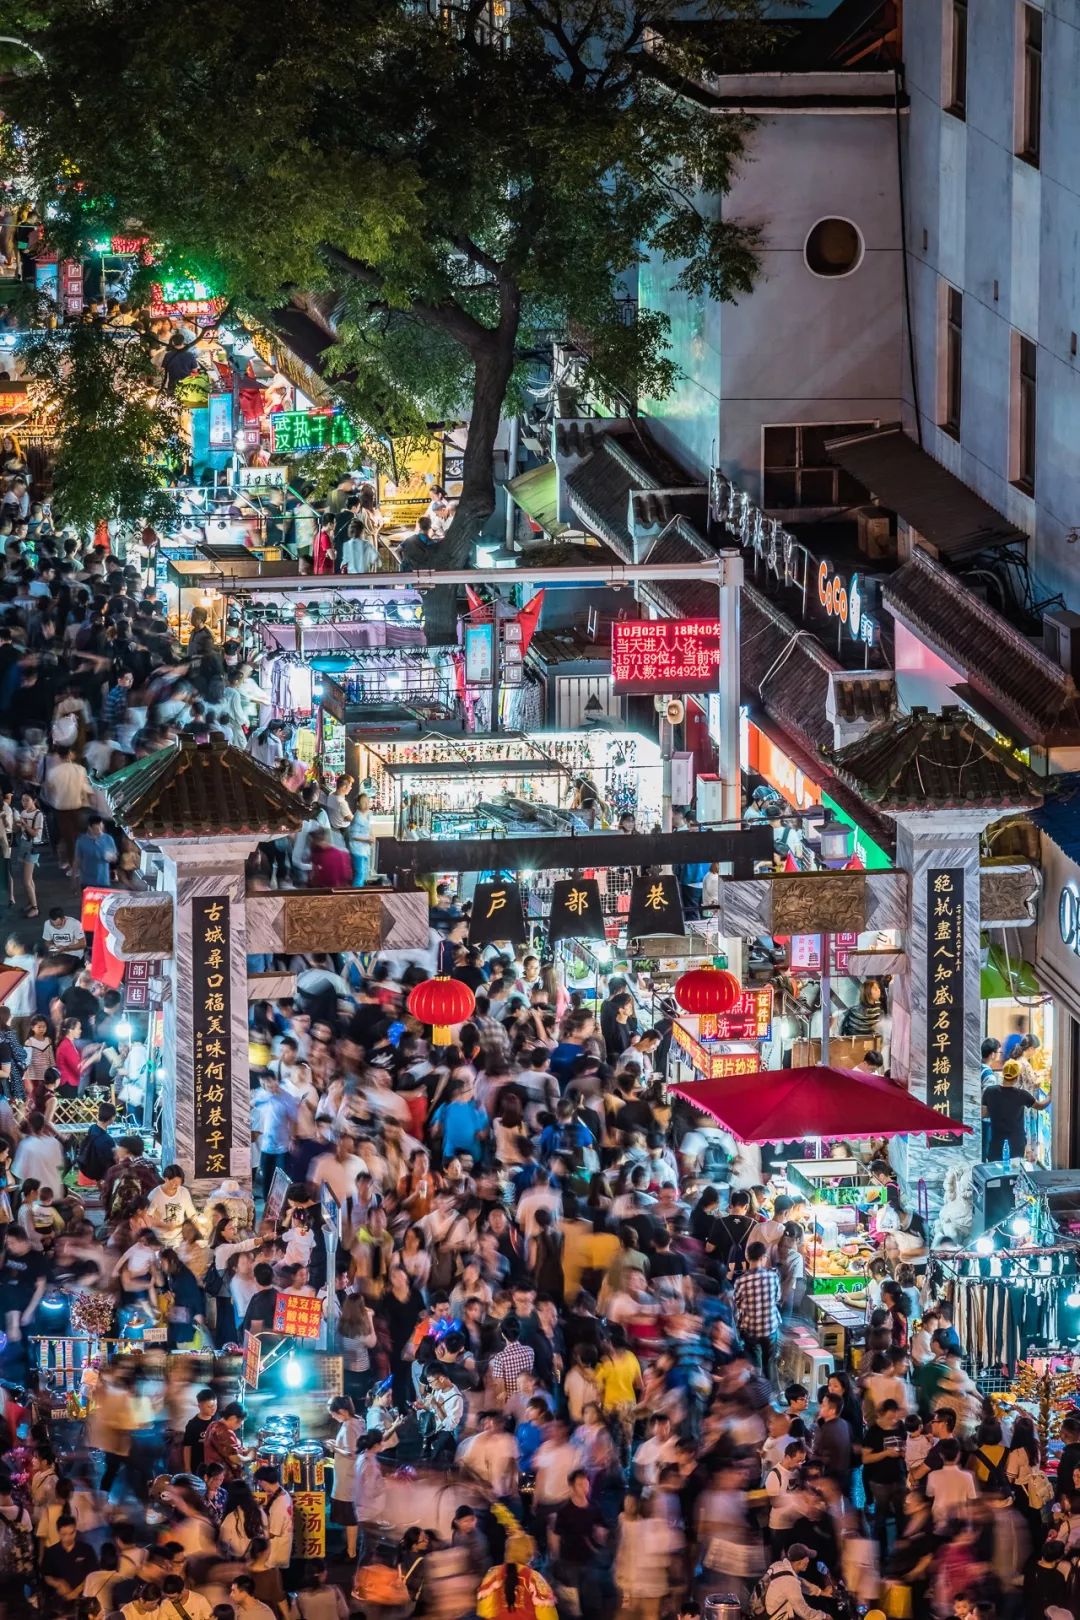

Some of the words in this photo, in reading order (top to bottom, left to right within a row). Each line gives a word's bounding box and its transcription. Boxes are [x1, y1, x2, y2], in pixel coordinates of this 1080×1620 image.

[275, 415, 291, 449] 武汉
[818, 560, 848, 624] CoCo
[617, 625, 667, 637] 10月02日
[704, 1018, 756, 1038] 秒洗一元
